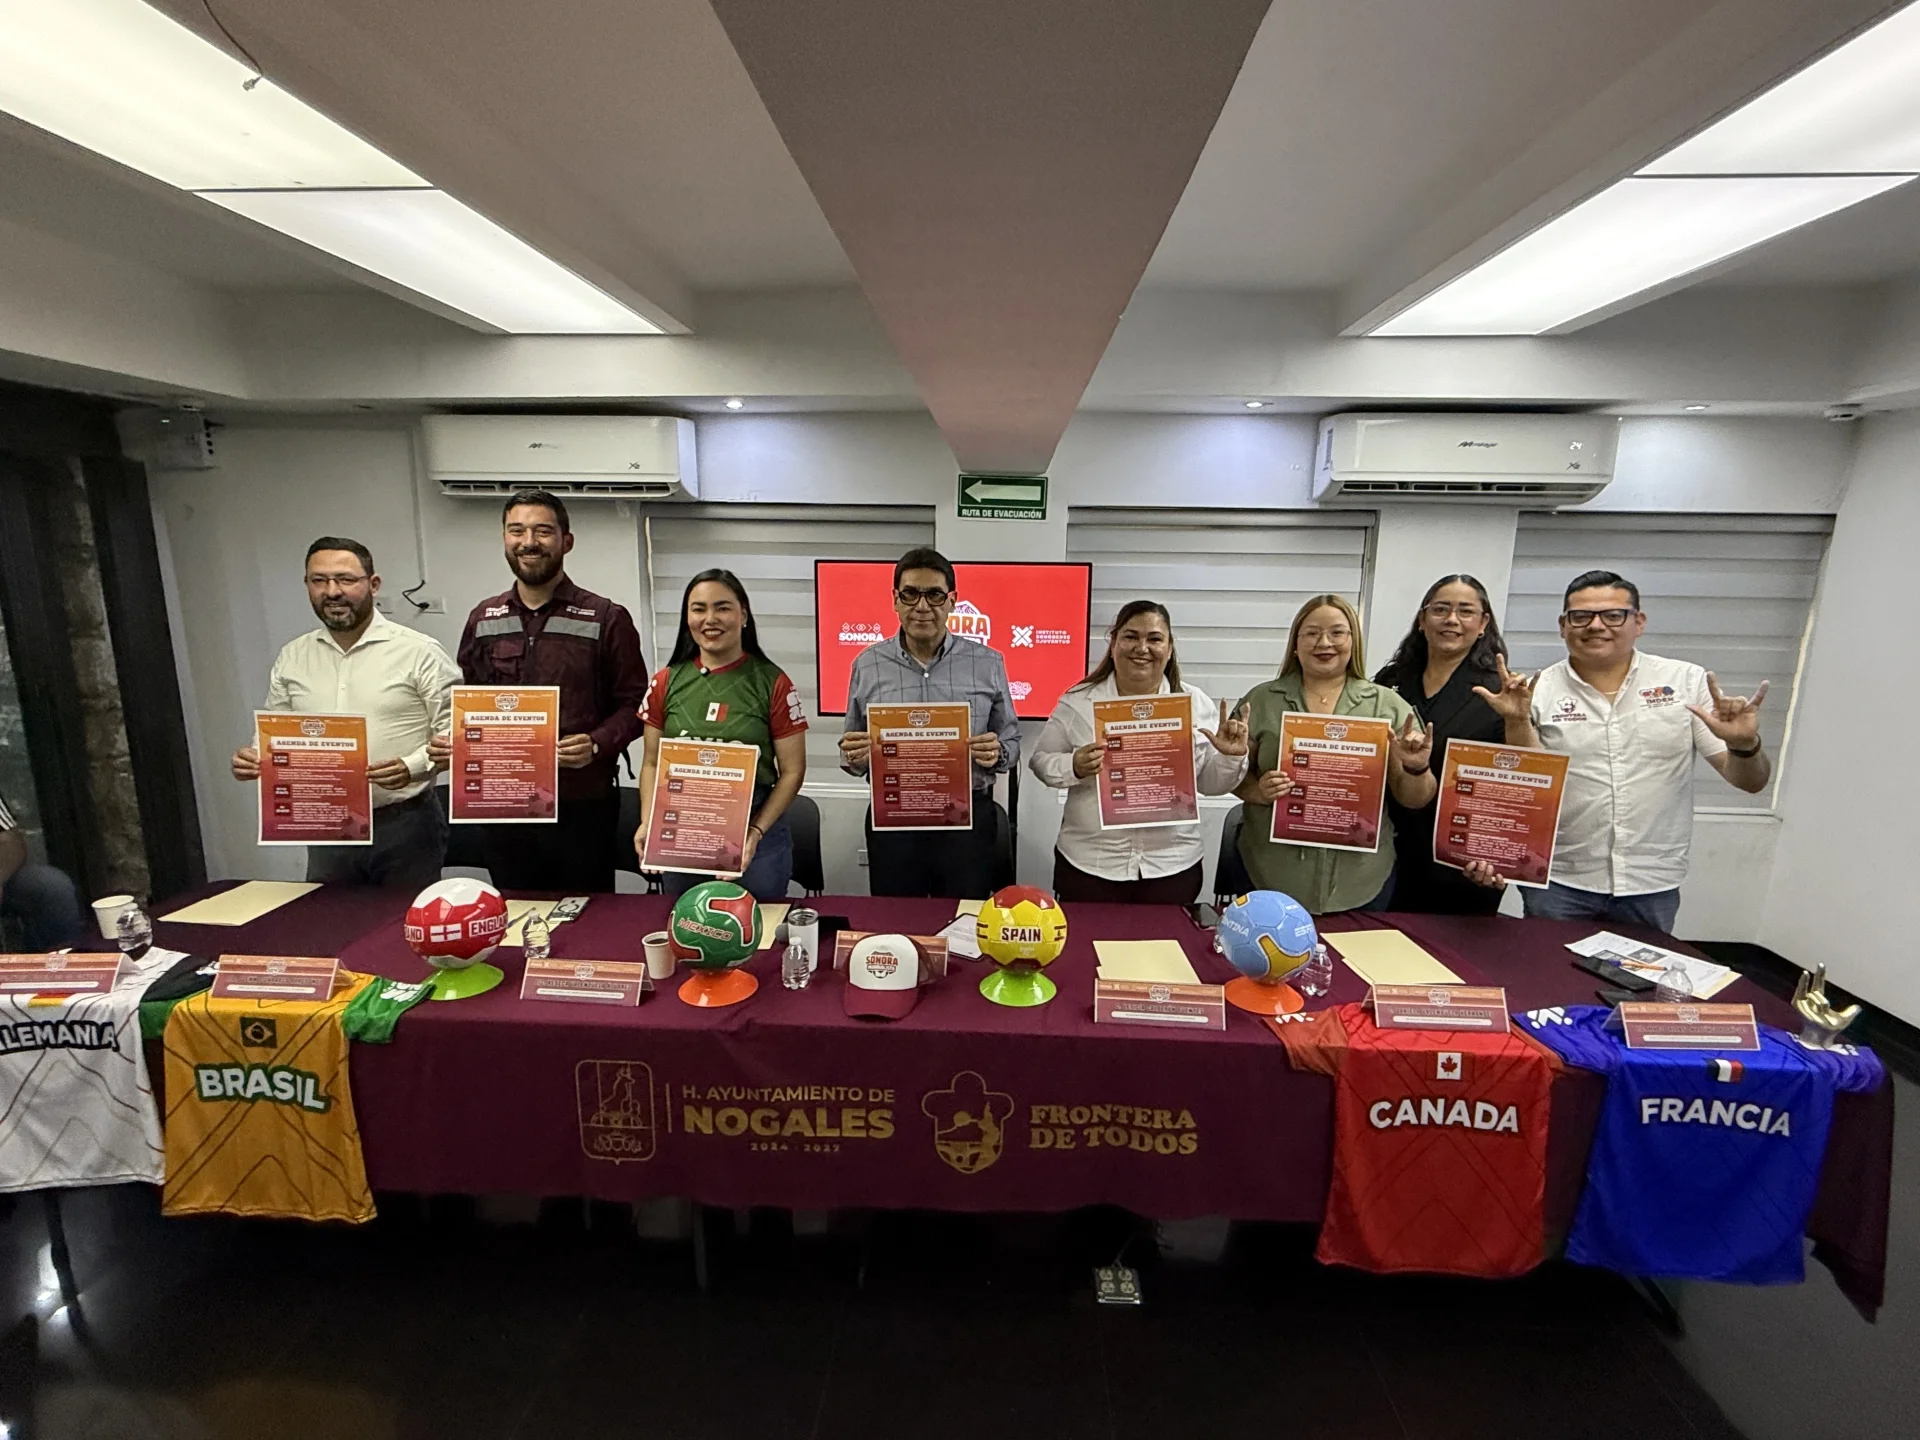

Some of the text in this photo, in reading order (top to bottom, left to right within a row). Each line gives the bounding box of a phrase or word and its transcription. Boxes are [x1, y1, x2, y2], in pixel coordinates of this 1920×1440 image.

[962, 509, 980, 517] RUTA
[994, 509, 1042, 519] EVACUACIÓN
[948, 614, 988, 637] ORA
[838, 632, 884, 642] SONORA
[1298, 742, 1327, 750] AGENDA
[1341, 744, 1374, 753] EVENTOS
[674, 767, 700, 775] AGENDA
[712, 770, 742, 778] EVENTOS
[1463, 768, 1549, 784] AGENDA DE EVENTOS
[1001, 927, 1041, 942] SPAIN
[866, 956, 898, 966] SONORA
[198, 1067, 325, 1110] BRASIL
[682, 1084, 896, 1103] H. AYUNTAMIENTO DE
[683, 1104, 896, 1139] NOGALES
[1030, 1103, 1197, 1130] FRONTERA
[1369, 1098, 1519, 1133] CANADA
[1641, 1098, 1791, 1137] FRANCIA
[750, 1142, 841, 1153] 2024 2027
[1029, 1125, 1198, 1155] DE TODOS
